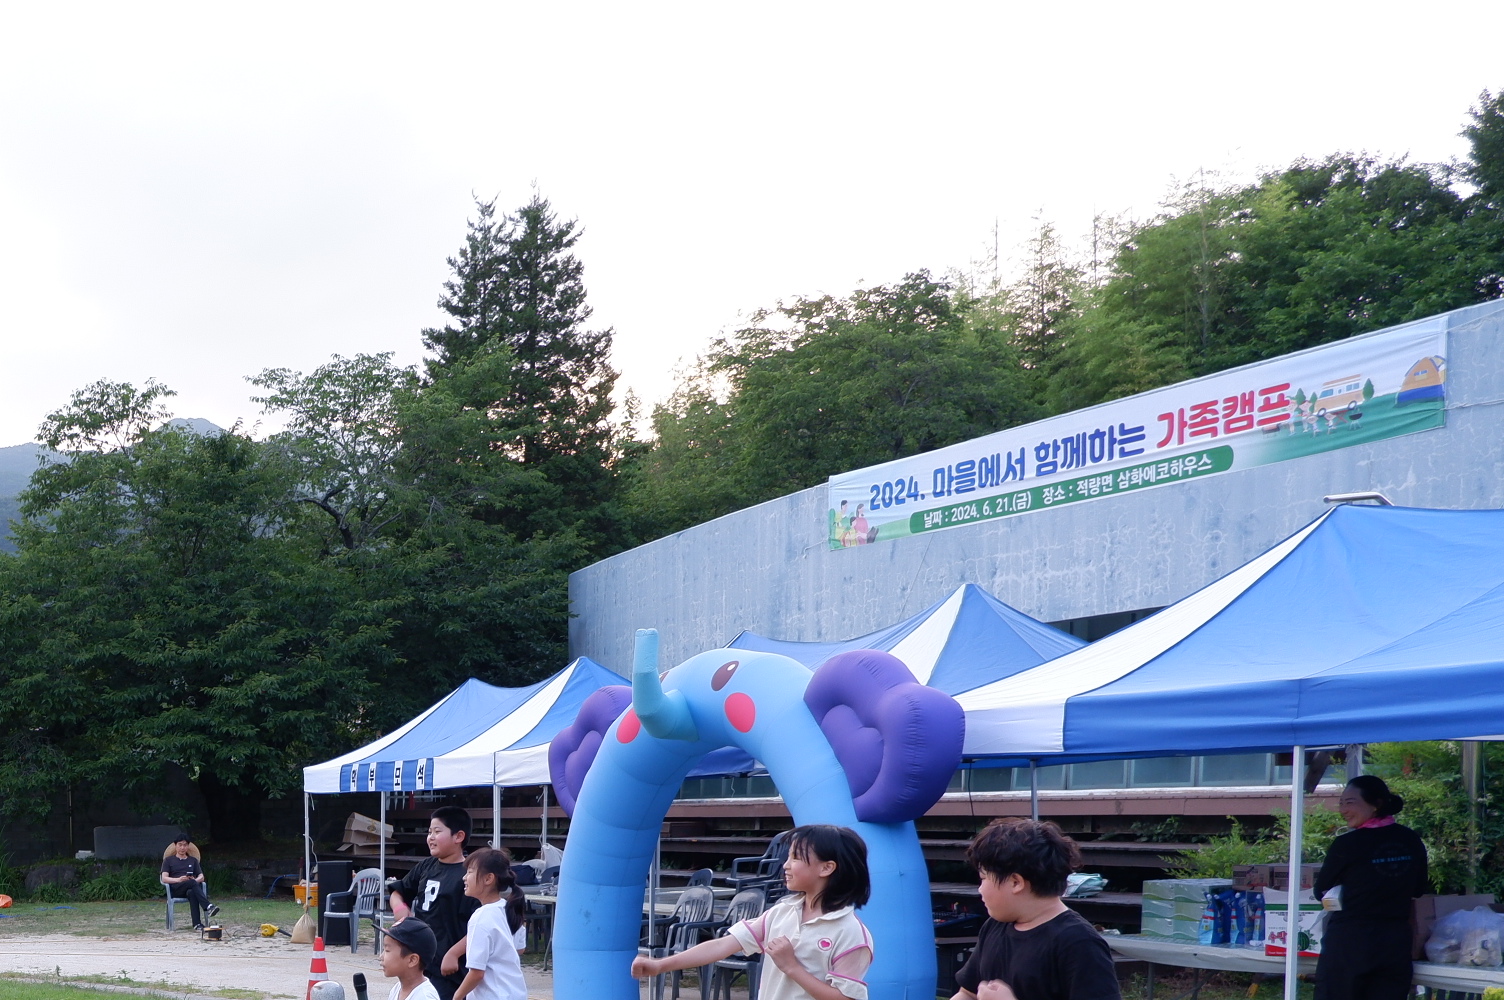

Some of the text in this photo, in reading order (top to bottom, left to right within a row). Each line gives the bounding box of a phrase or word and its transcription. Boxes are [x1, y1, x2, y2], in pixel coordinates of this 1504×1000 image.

[869, 382, 1291, 511] 2024. 마을에서 함께하는 가족캠프
[923, 510, 943, 529] 날짜
[951, 503, 980, 522] 2024.
[1042, 486, 1066, 505] 장소
[1076, 473, 1114, 498] 적량면
[1117, 453, 1213, 489] 삼화에코하우스
[422, 880, 441, 911] P
